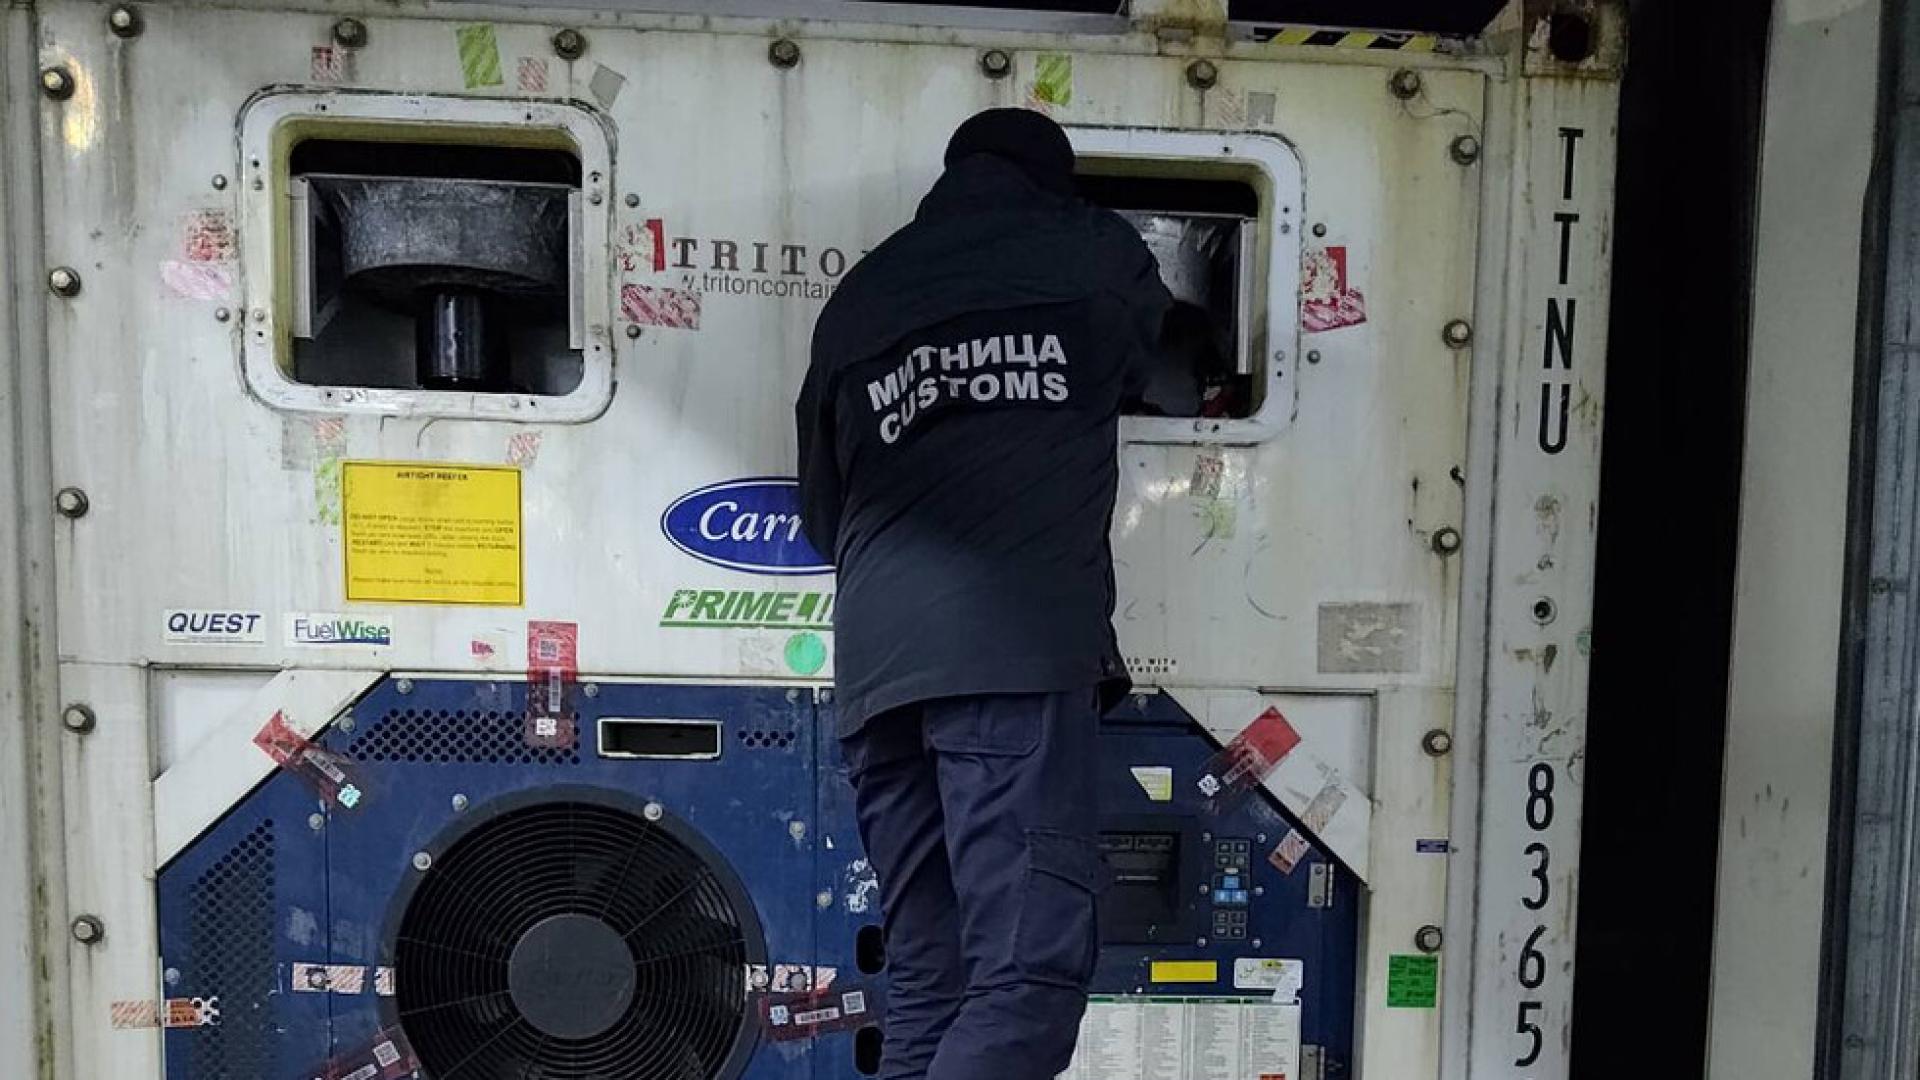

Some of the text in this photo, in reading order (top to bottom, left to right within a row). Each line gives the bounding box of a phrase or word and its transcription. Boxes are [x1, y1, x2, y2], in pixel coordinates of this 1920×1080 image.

[671, 237, 866, 277] TRITO
[1539, 127, 1584, 455] TTNU
[867, 333, 1068, 412] МИТНИЦА
[879, 370, 1069, 444] CUSTOMS
[167, 612, 261, 634] QUEST
[294, 618, 391, 640] FuelWise
